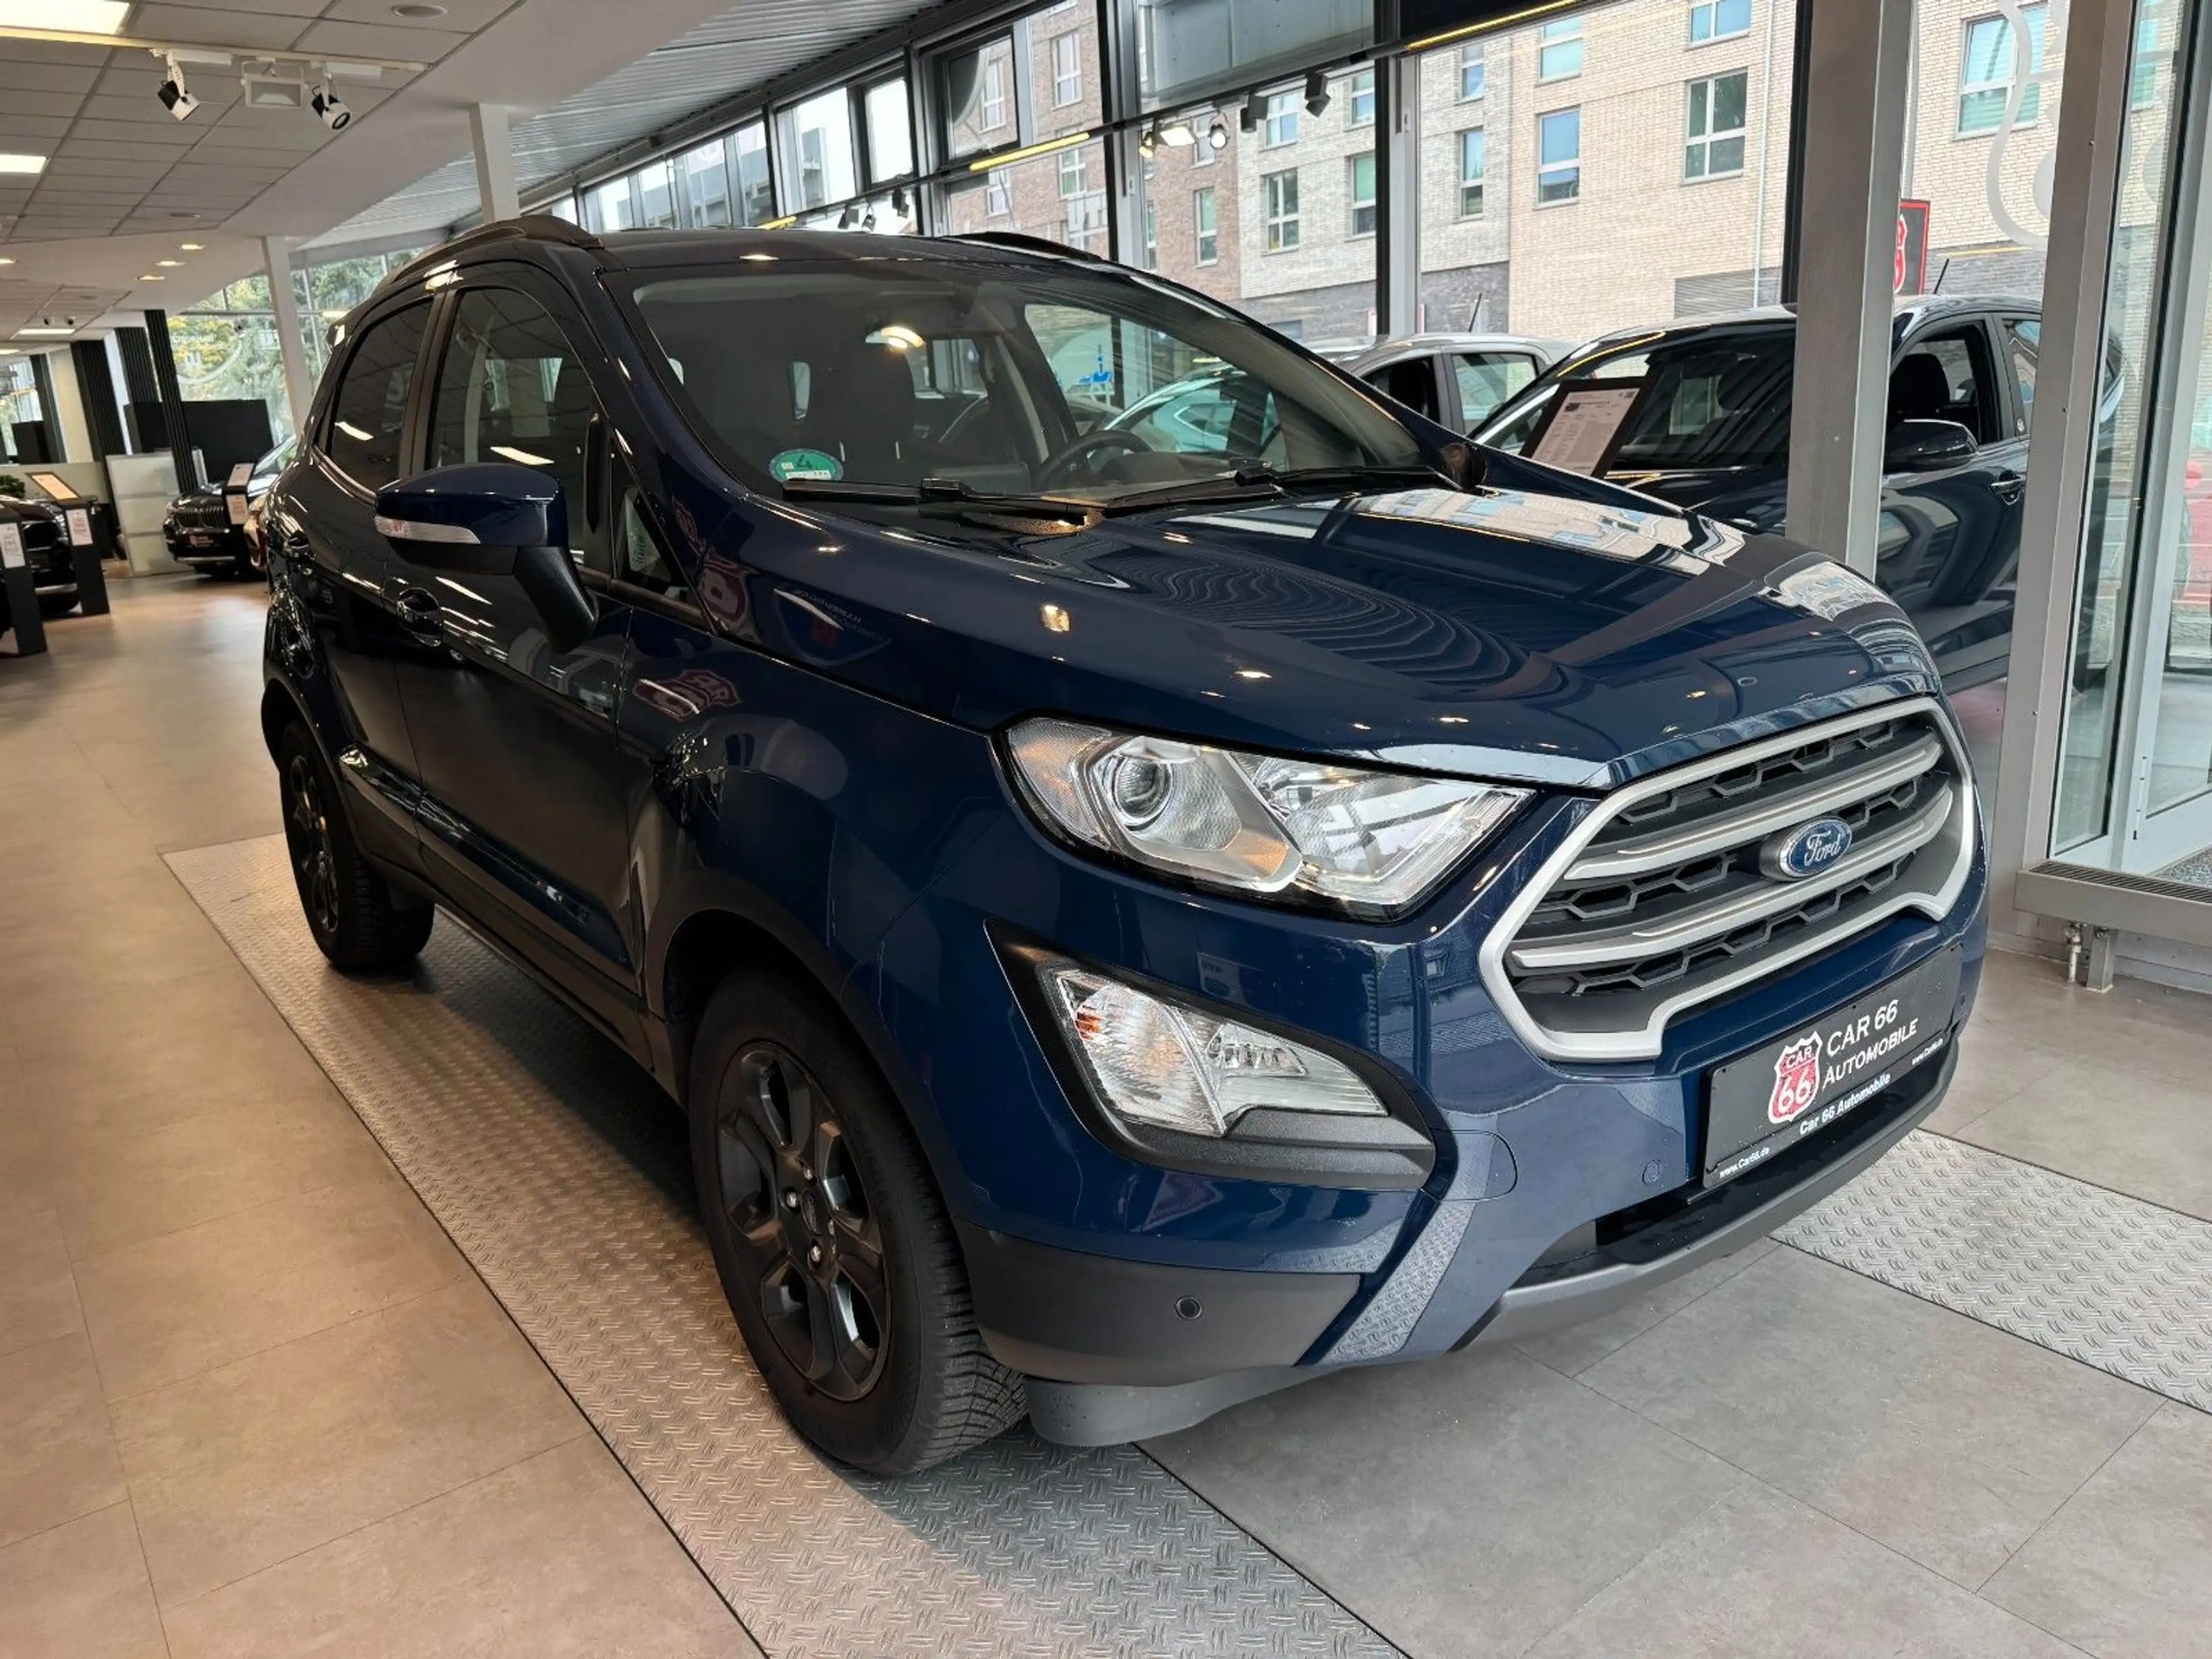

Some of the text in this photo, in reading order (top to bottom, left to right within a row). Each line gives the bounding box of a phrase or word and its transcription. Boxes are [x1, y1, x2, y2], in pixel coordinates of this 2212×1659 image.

[796, 454, 813, 469] 4
[1804, 830, 1841, 866] Ford
[1827, 999, 1899, 1058] CAR 66
[1786, 1045, 1813, 1067] CAR
[1822, 1017, 1919, 1092] AUTOMOBILE
[1778, 1067, 1811, 1113] 66
[1800, 1073, 1891, 1135] Car 66 Automobile
